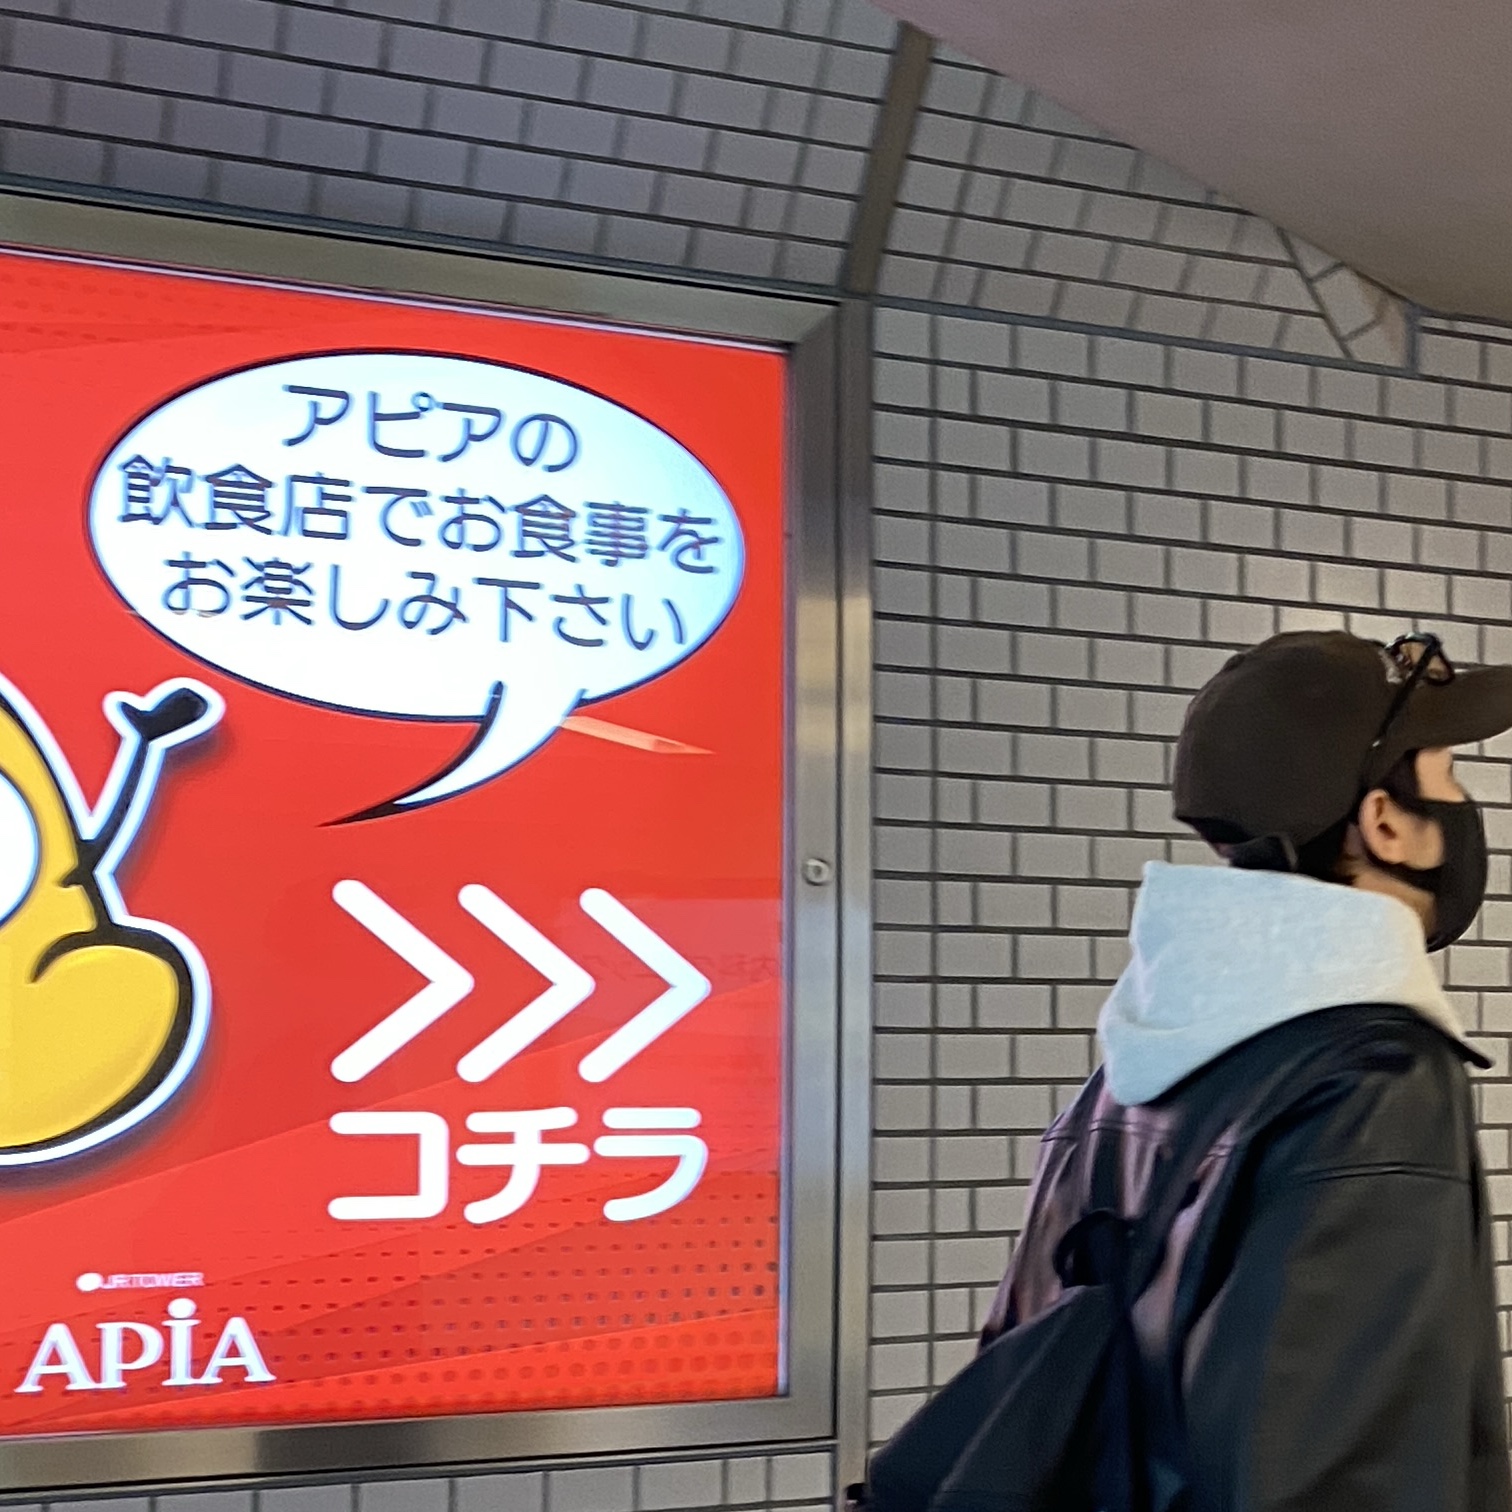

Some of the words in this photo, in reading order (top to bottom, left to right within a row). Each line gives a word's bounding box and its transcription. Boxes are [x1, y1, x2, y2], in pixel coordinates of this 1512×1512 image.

[283, 384, 578, 472] アピアの
[118, 455, 724, 575] 飲食店でお食事を
[162, 554, 687, 651] お楽しみ下さい
[328, 1106, 708, 1222] コチラ
